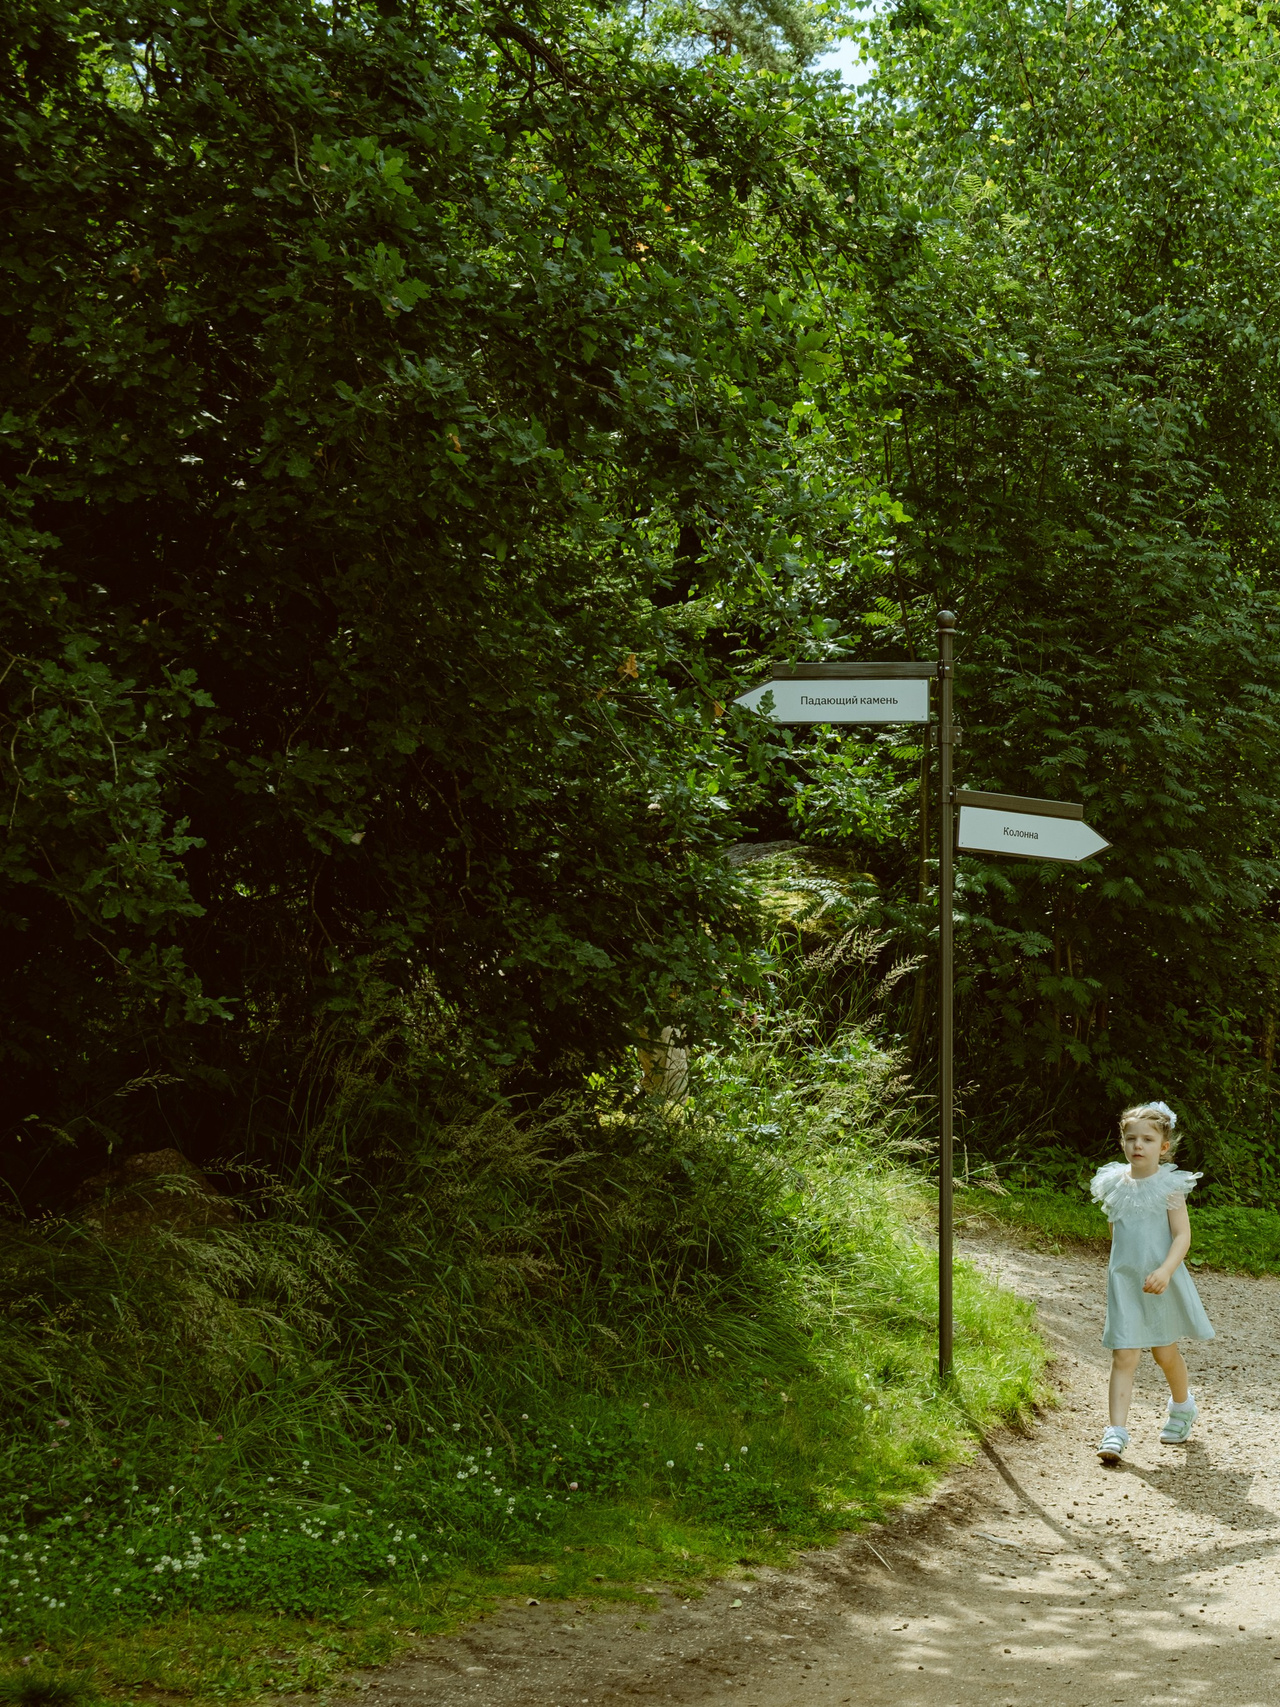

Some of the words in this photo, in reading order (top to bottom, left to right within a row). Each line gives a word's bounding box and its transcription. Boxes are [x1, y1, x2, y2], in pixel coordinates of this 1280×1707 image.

[800, 695, 858, 706] Падающий
[860, 697, 899, 705] камень
[1003, 826, 1039, 840] Колонна
